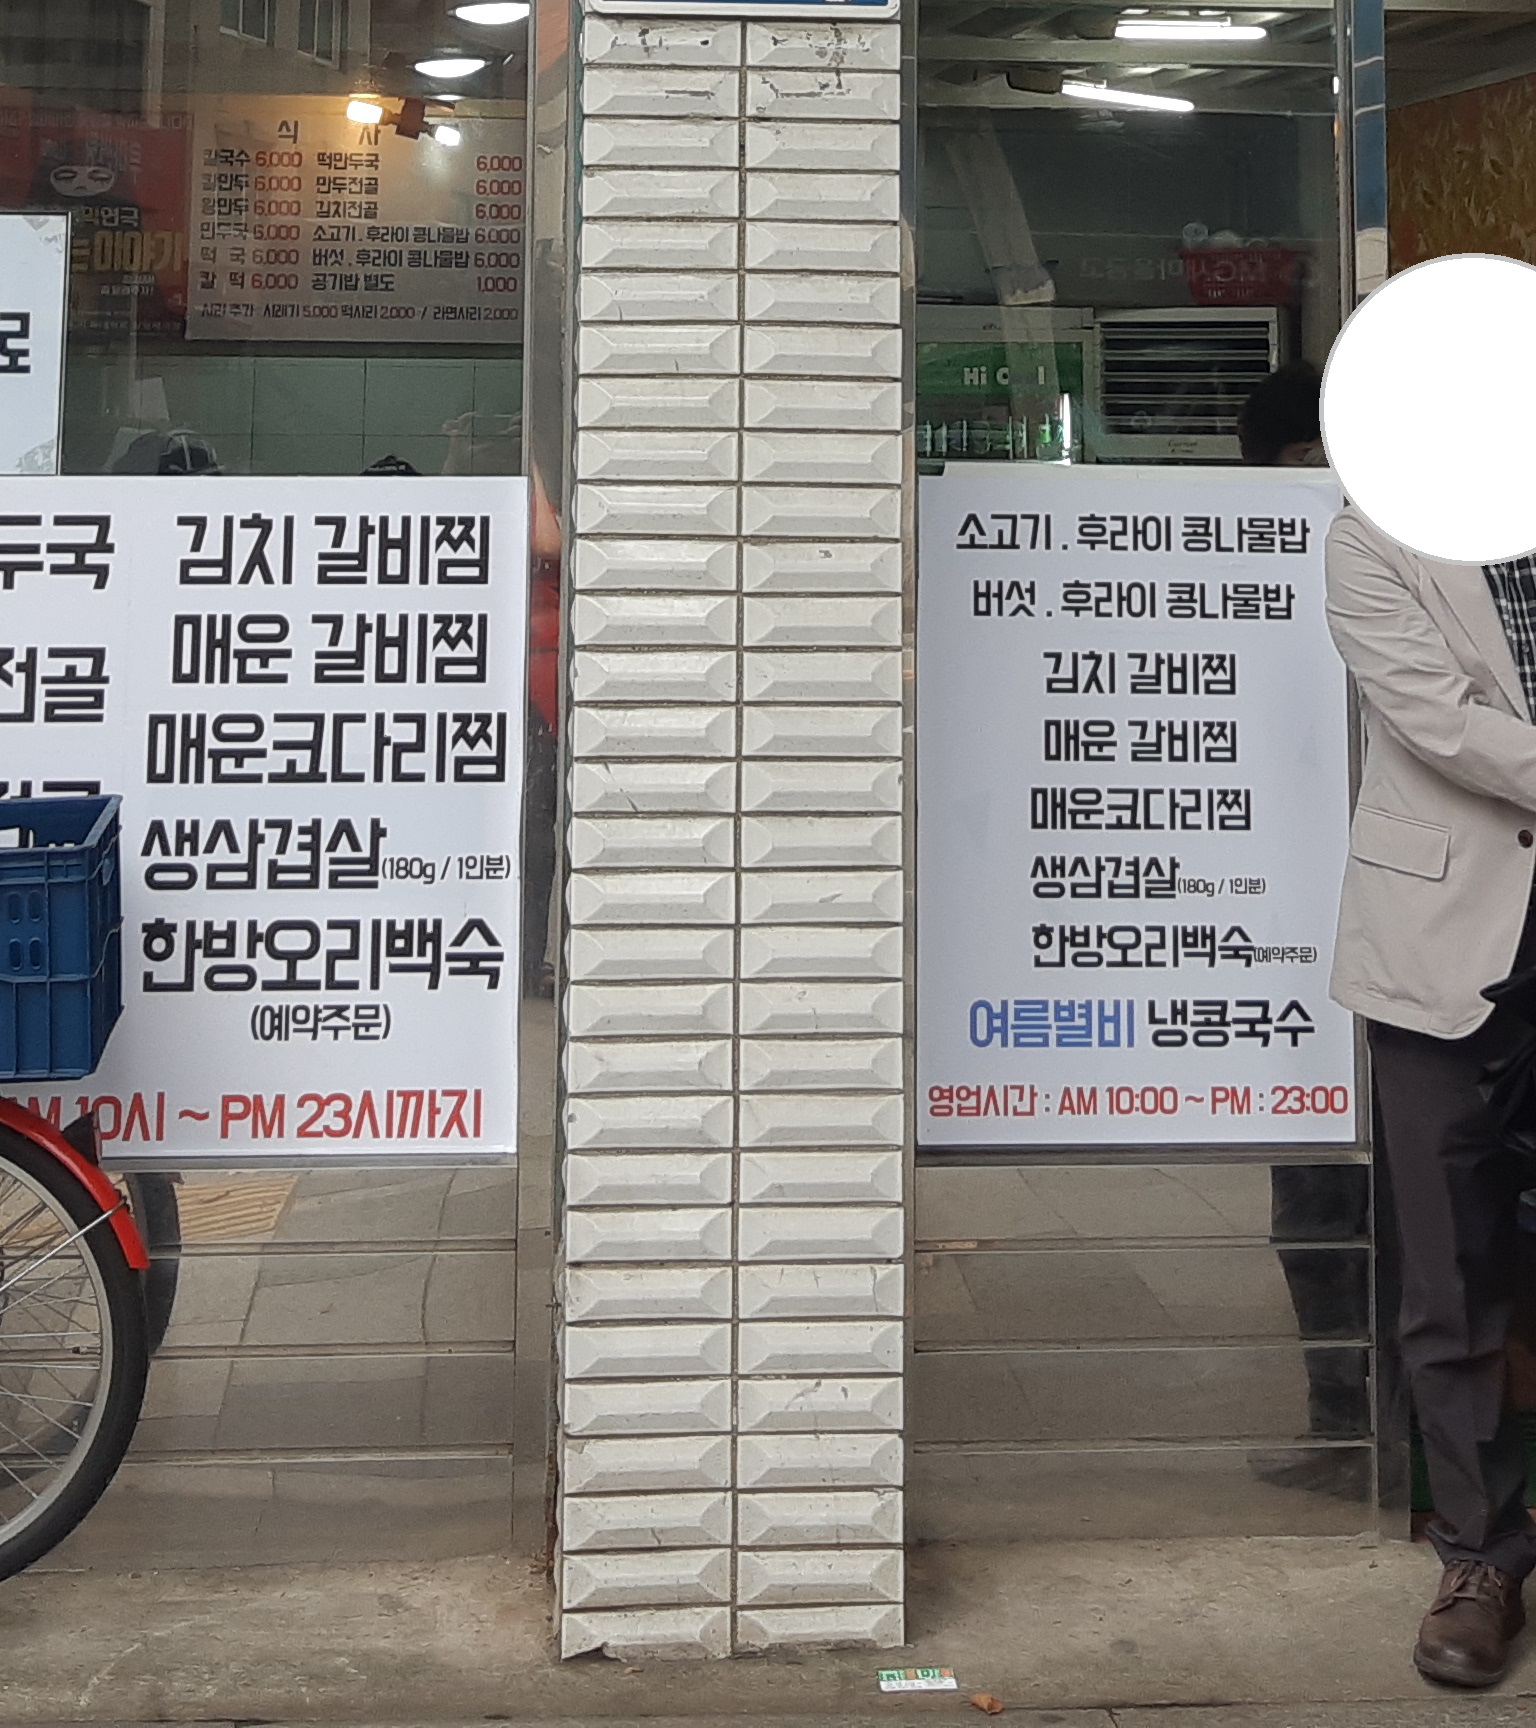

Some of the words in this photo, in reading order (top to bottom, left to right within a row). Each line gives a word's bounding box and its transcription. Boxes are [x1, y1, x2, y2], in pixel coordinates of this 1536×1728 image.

[317, 152, 380, 171] 떡만두국
[476, 155, 523, 172] 6,000
[316, 176, 379, 195] 만두전골
[476, 179, 522, 196] 6,000
[176, 513, 295, 586] 김치
[313, 515, 491, 586] 갈비찜
[1076, 513, 1173, 552] 후라이
[1182, 515, 1311, 554] 콩나물밥
[1062, 579, 1157, 619] 후라이
[1166, 581, 1296, 621] 콩나물밥
[171, 613, 293, 685] 매운
[311, 613, 489, 685] 갈비찜
[1042, 651, 1116, 695] 김치
[1127, 652, 1238, 696] 갈비찜
[146, 712, 508, 785] 매운코다리찜
[1044, 719, 1118, 762] 매운
[1128, 719, 1238, 763] 갈비찜
[1030, 787, 1252, 832] 매운코다리찜
[141, 817, 388, 893] 생삼겹살
[1030, 855, 1181, 900] 생삼겹살
[141, 917, 506, 994] 한방오리백숙
[1031, 923, 1255, 969] 한방오리백숙
[250, 1004, 393, 1043] (예약주문)
[968, 999, 1135, 1048] 여름별비
[1147, 999, 1316, 1048] 냉콩국수
[221, 1093, 285, 1139] PM
[296, 1089, 482, 1140] 23시까지
[1058, 1088, 1099, 1116] AM
[1106, 1085, 1179, 1115] 10:00
[1270, 1085, 1349, 1115] 23:00
